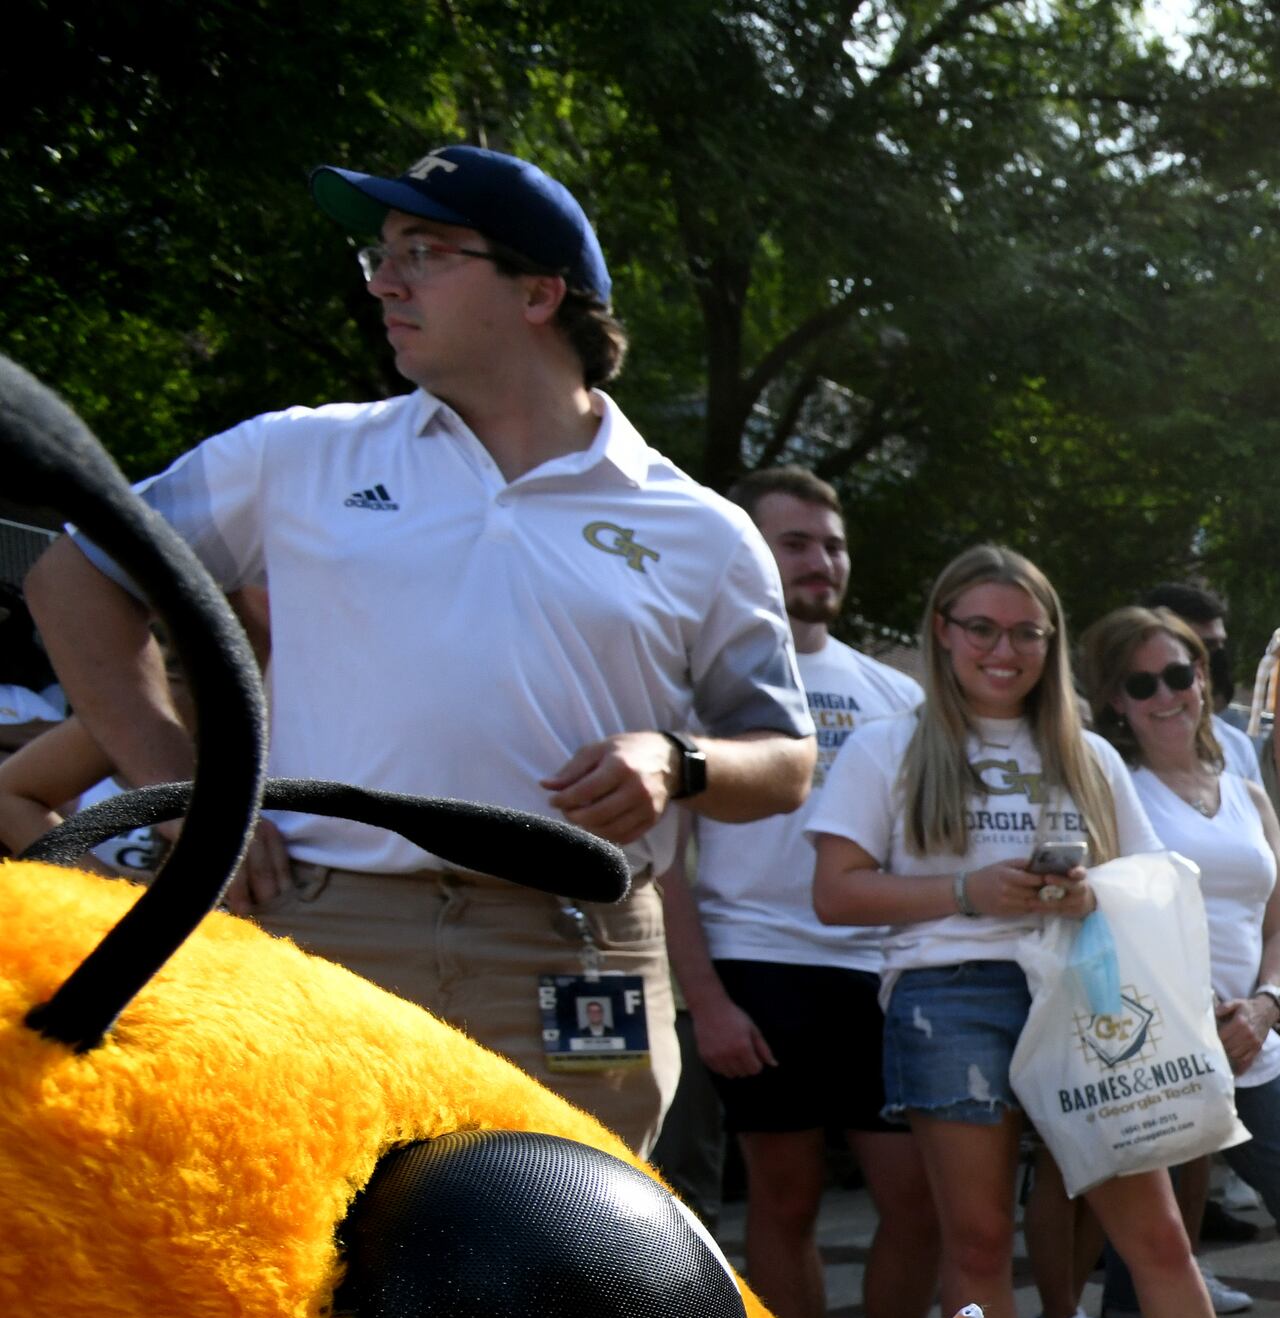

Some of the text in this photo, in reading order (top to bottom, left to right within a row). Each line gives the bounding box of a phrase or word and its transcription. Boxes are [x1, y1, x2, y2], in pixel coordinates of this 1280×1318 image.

[581, 520, 661, 574] GT
[1095, 1014, 1134, 1041] GT
[1098, 1093, 1163, 1120] Georgia
[1161, 1081, 1203, 1100] Tech
